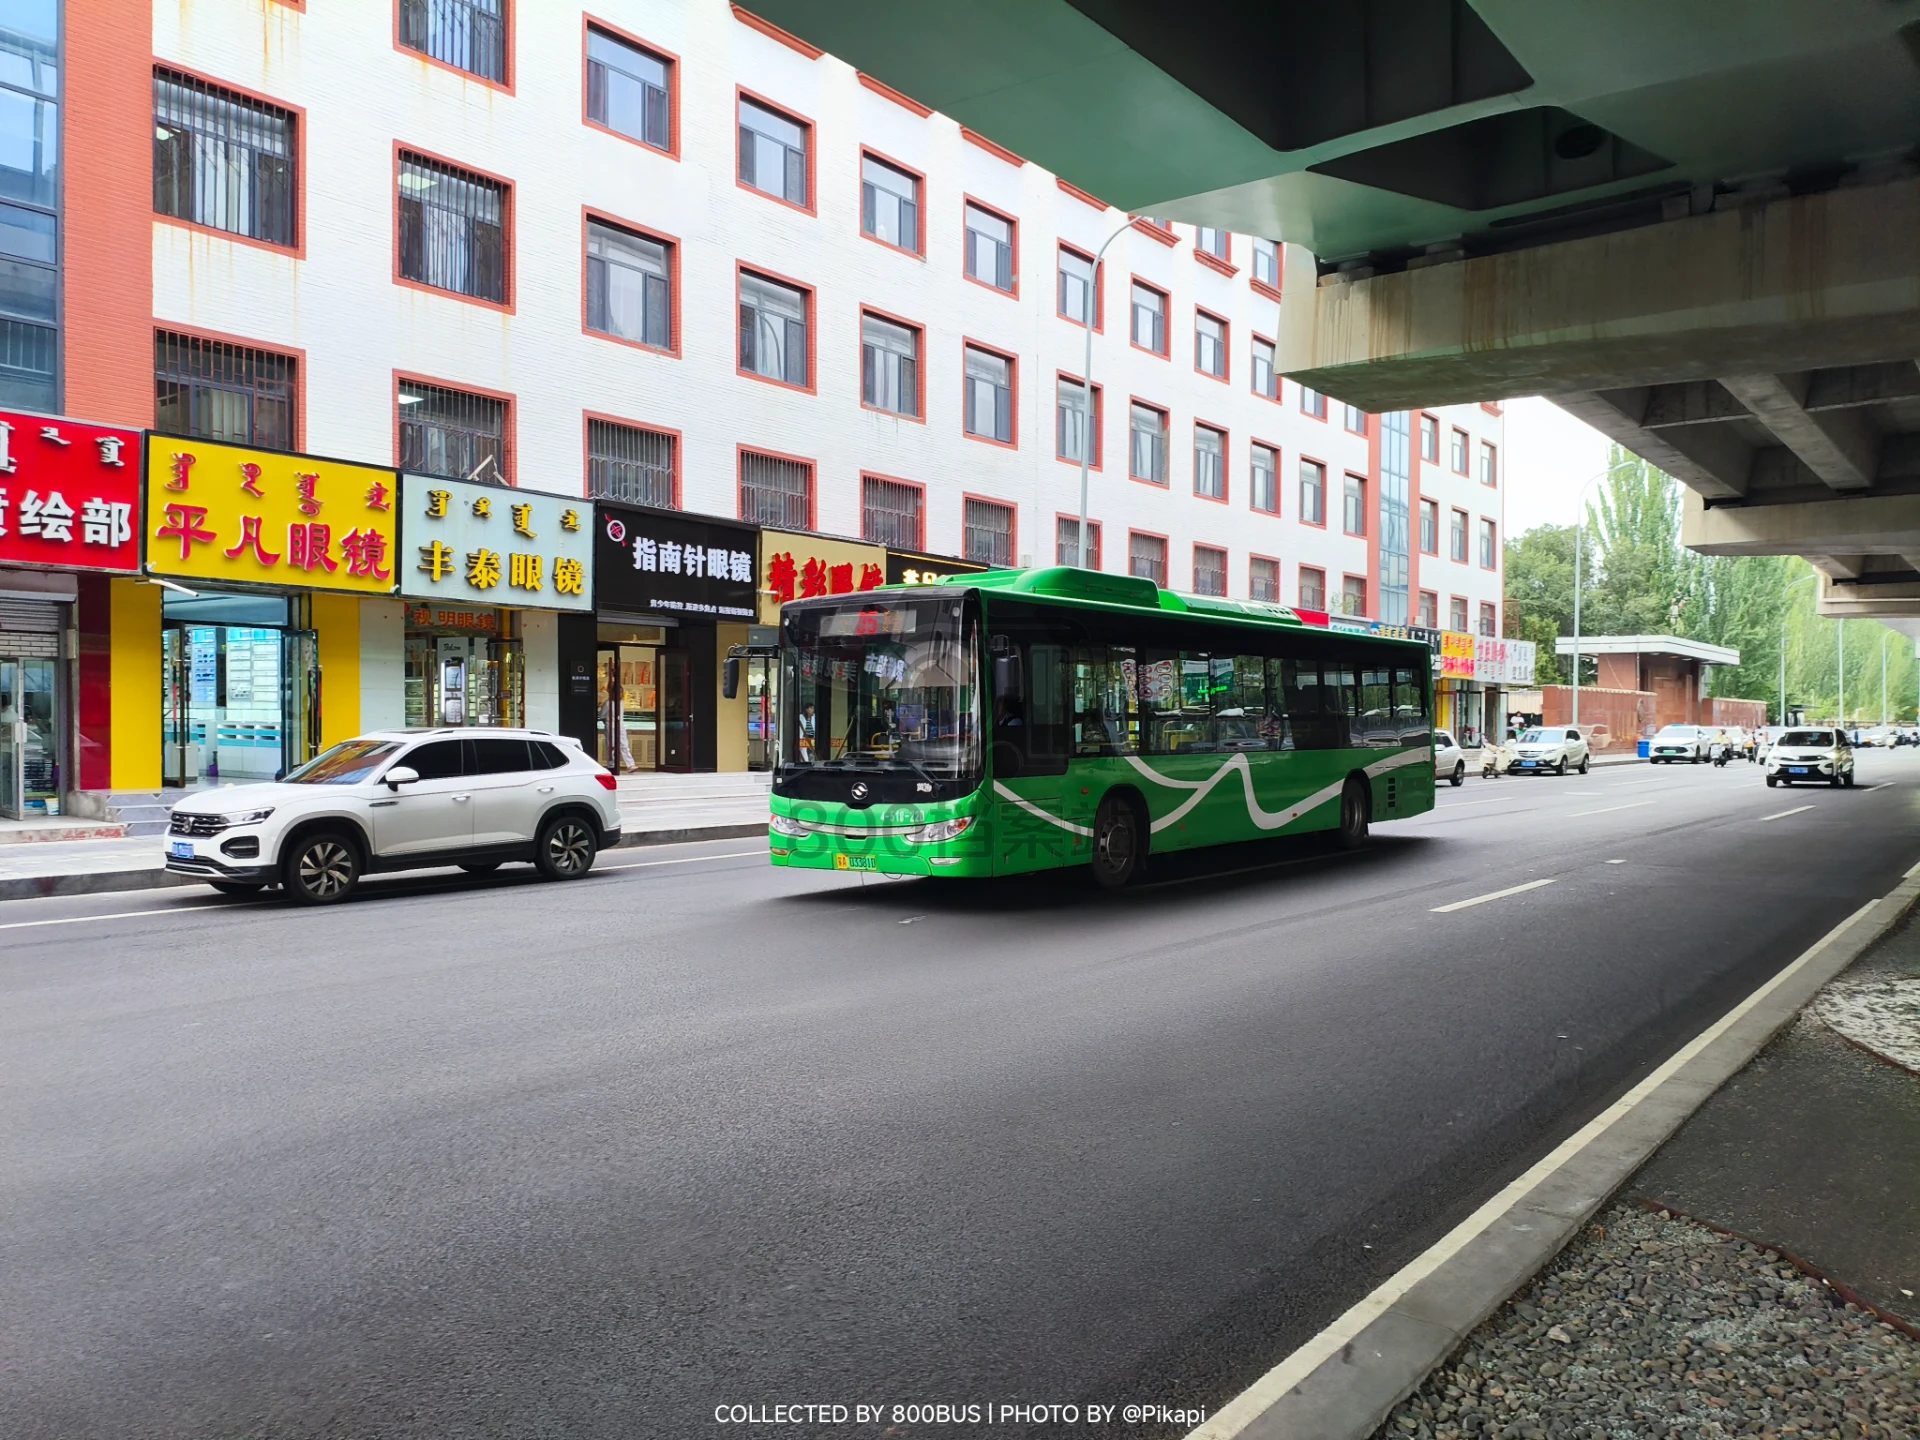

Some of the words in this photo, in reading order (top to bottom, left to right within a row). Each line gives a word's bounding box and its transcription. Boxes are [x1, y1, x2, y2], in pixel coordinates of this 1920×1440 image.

[156, 502, 391, 580] 平凡眼镜
[417, 540, 585, 596] 丰泰眼镜
[632, 536, 752, 583] 指南针眼镜
